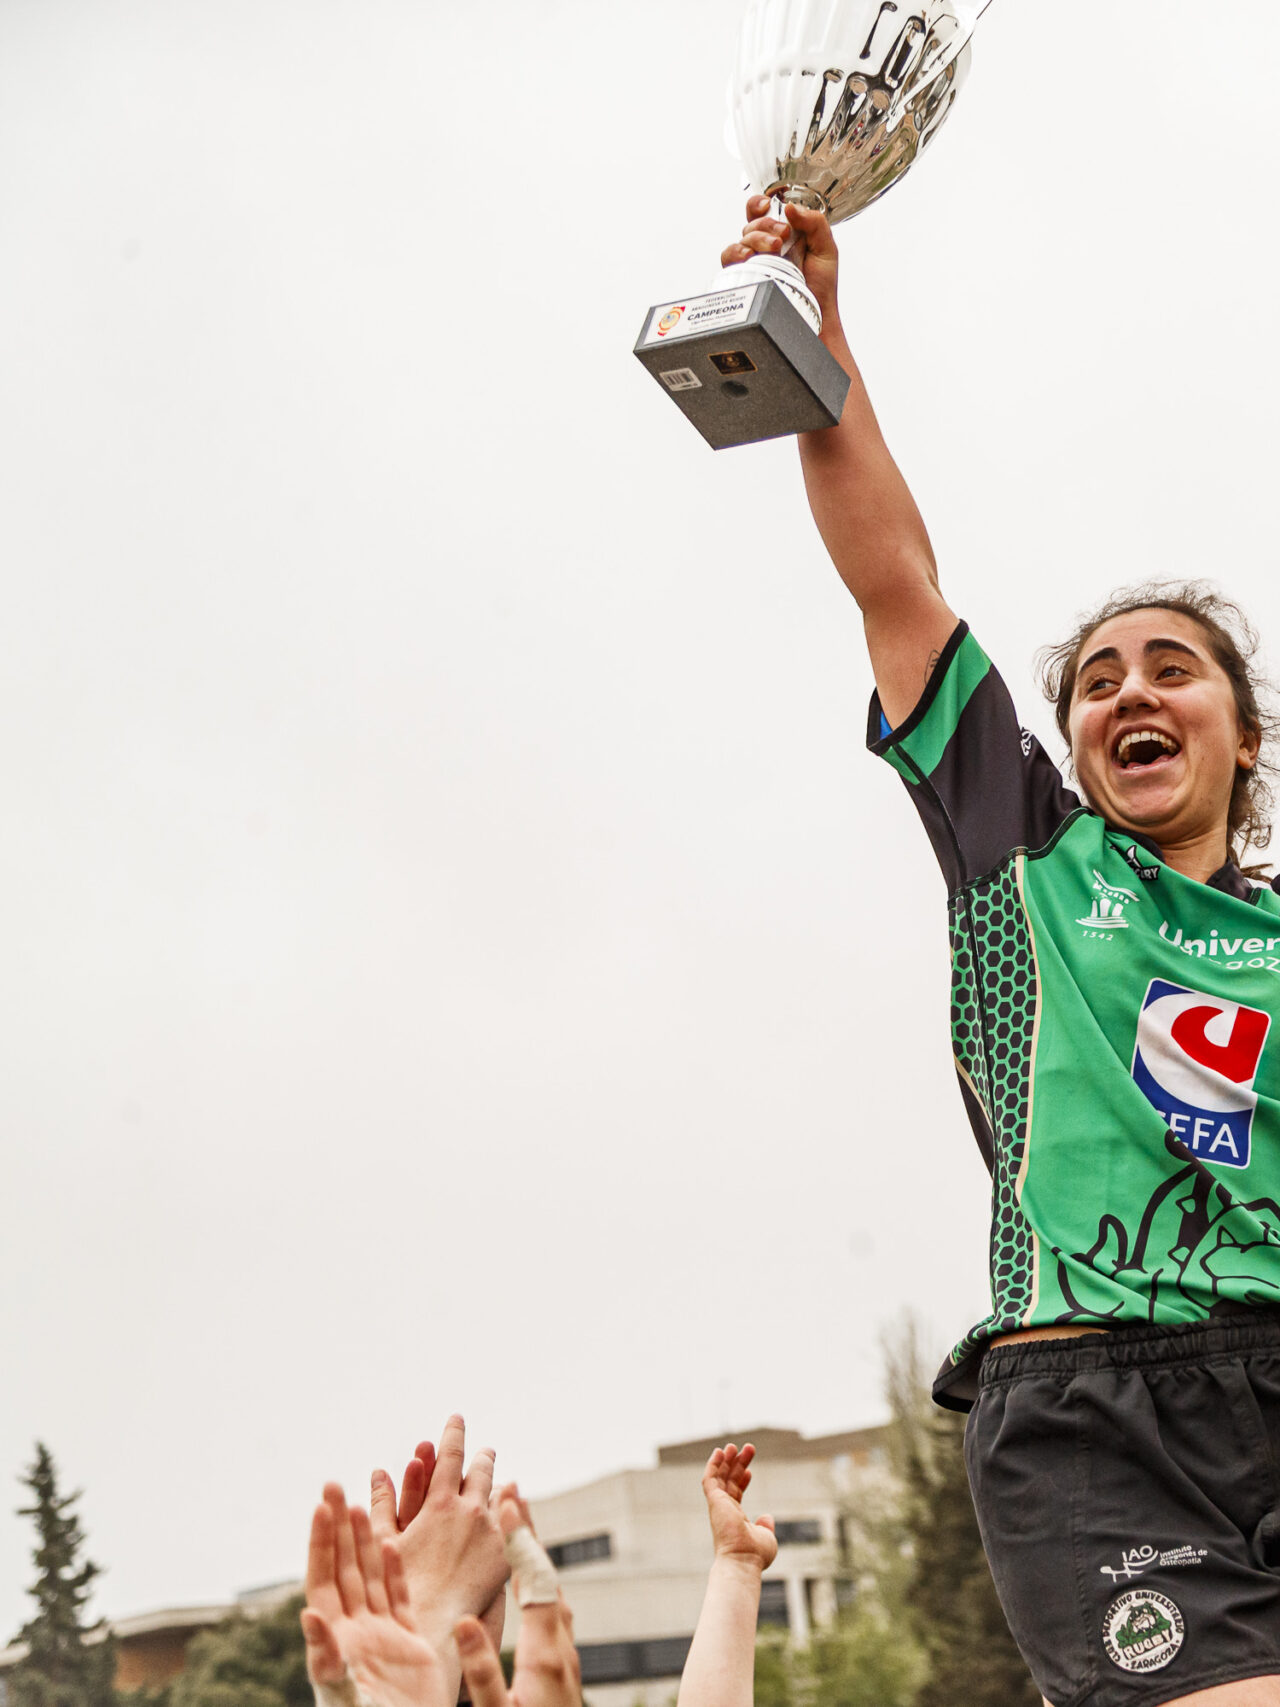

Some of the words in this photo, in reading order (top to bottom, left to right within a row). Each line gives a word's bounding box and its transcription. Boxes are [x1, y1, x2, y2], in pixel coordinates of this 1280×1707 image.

[688, 303, 744, 320] CAMPEONA
[1083, 930, 1114, 941] 1542
[1157, 1110, 1239, 1158] EFA
[1198, 1548, 1208, 1556] de
[1122, 1628, 1173, 1660] RUGBY
[1130, 1643, 1180, 1670] ZARAGOZA
